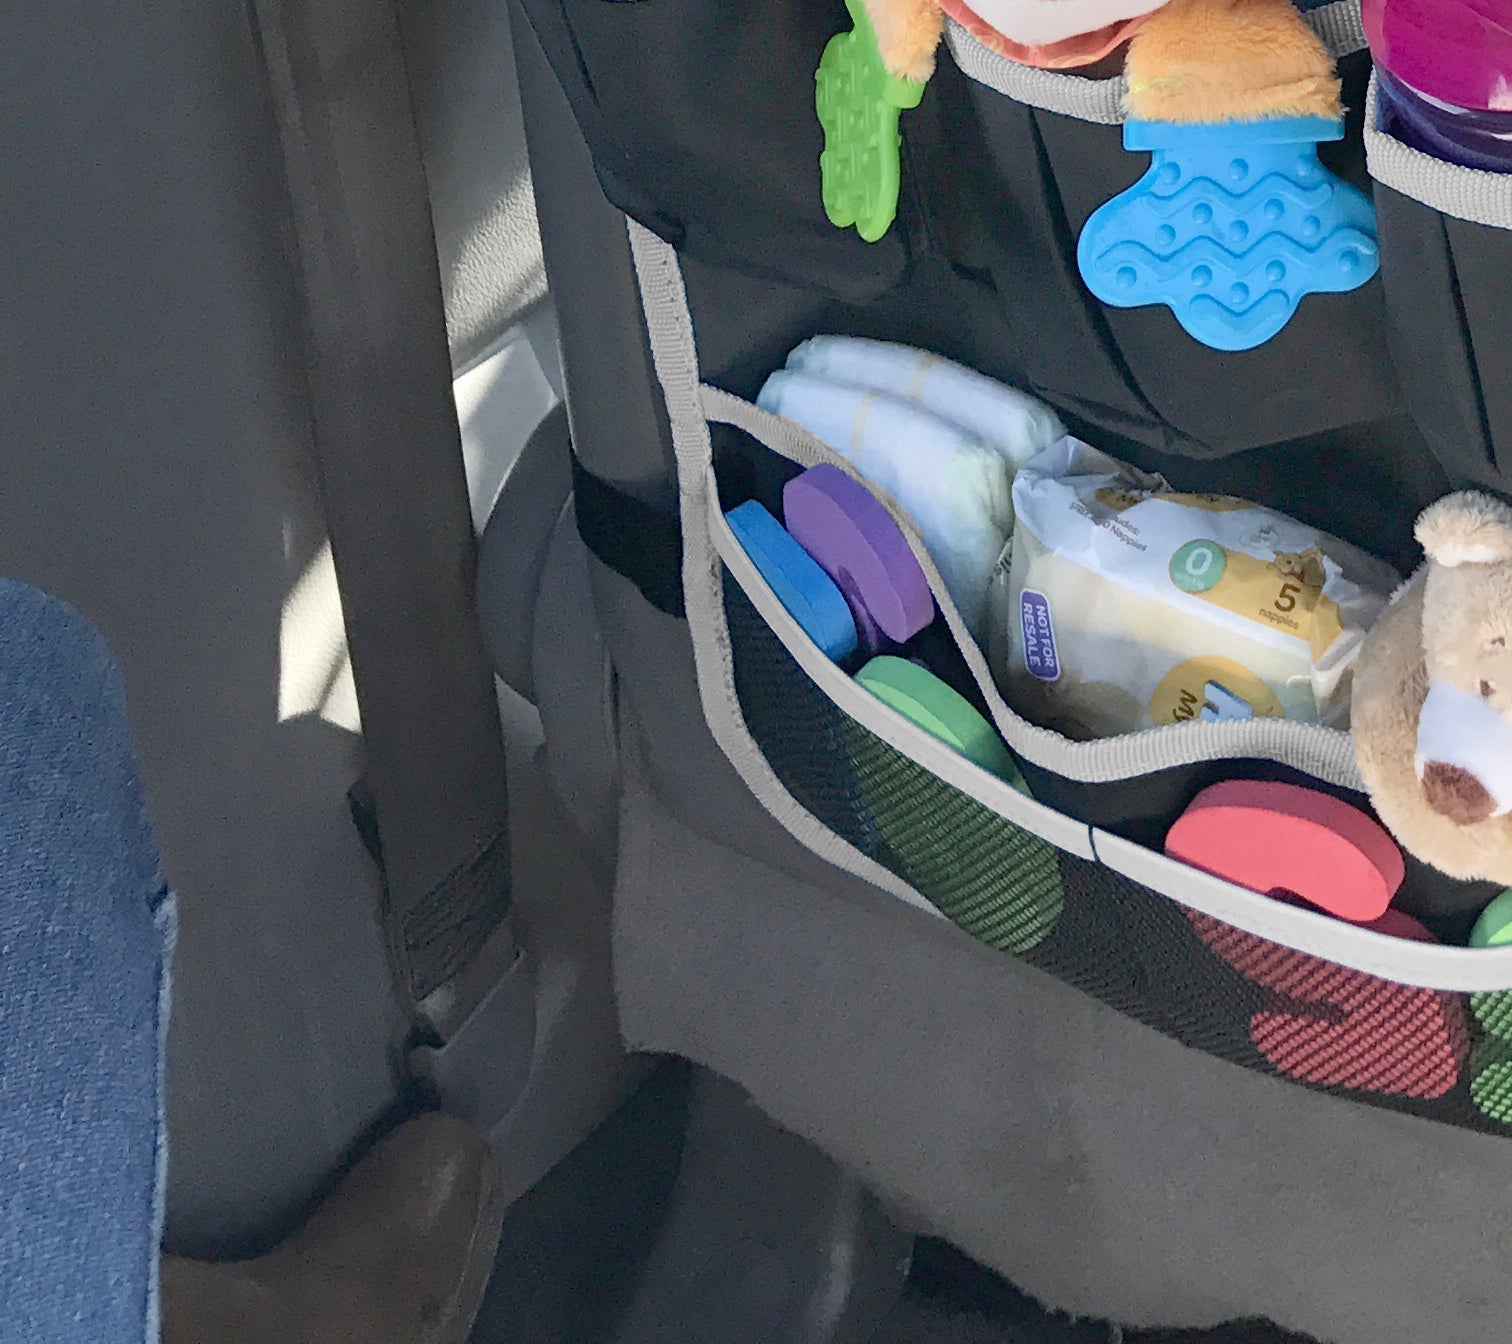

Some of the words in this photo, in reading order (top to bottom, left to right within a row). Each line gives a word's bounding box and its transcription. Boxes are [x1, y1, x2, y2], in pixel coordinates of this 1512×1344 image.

[1186, 547, 1213, 576] 0
[1274, 582, 1301, 612] 5
[1035, 604, 1050, 637] NOT
[1258, 607, 1300, 630] nappies
[1023, 602, 1041, 667] RESALE
[1040, 639, 1055, 668] FOR
